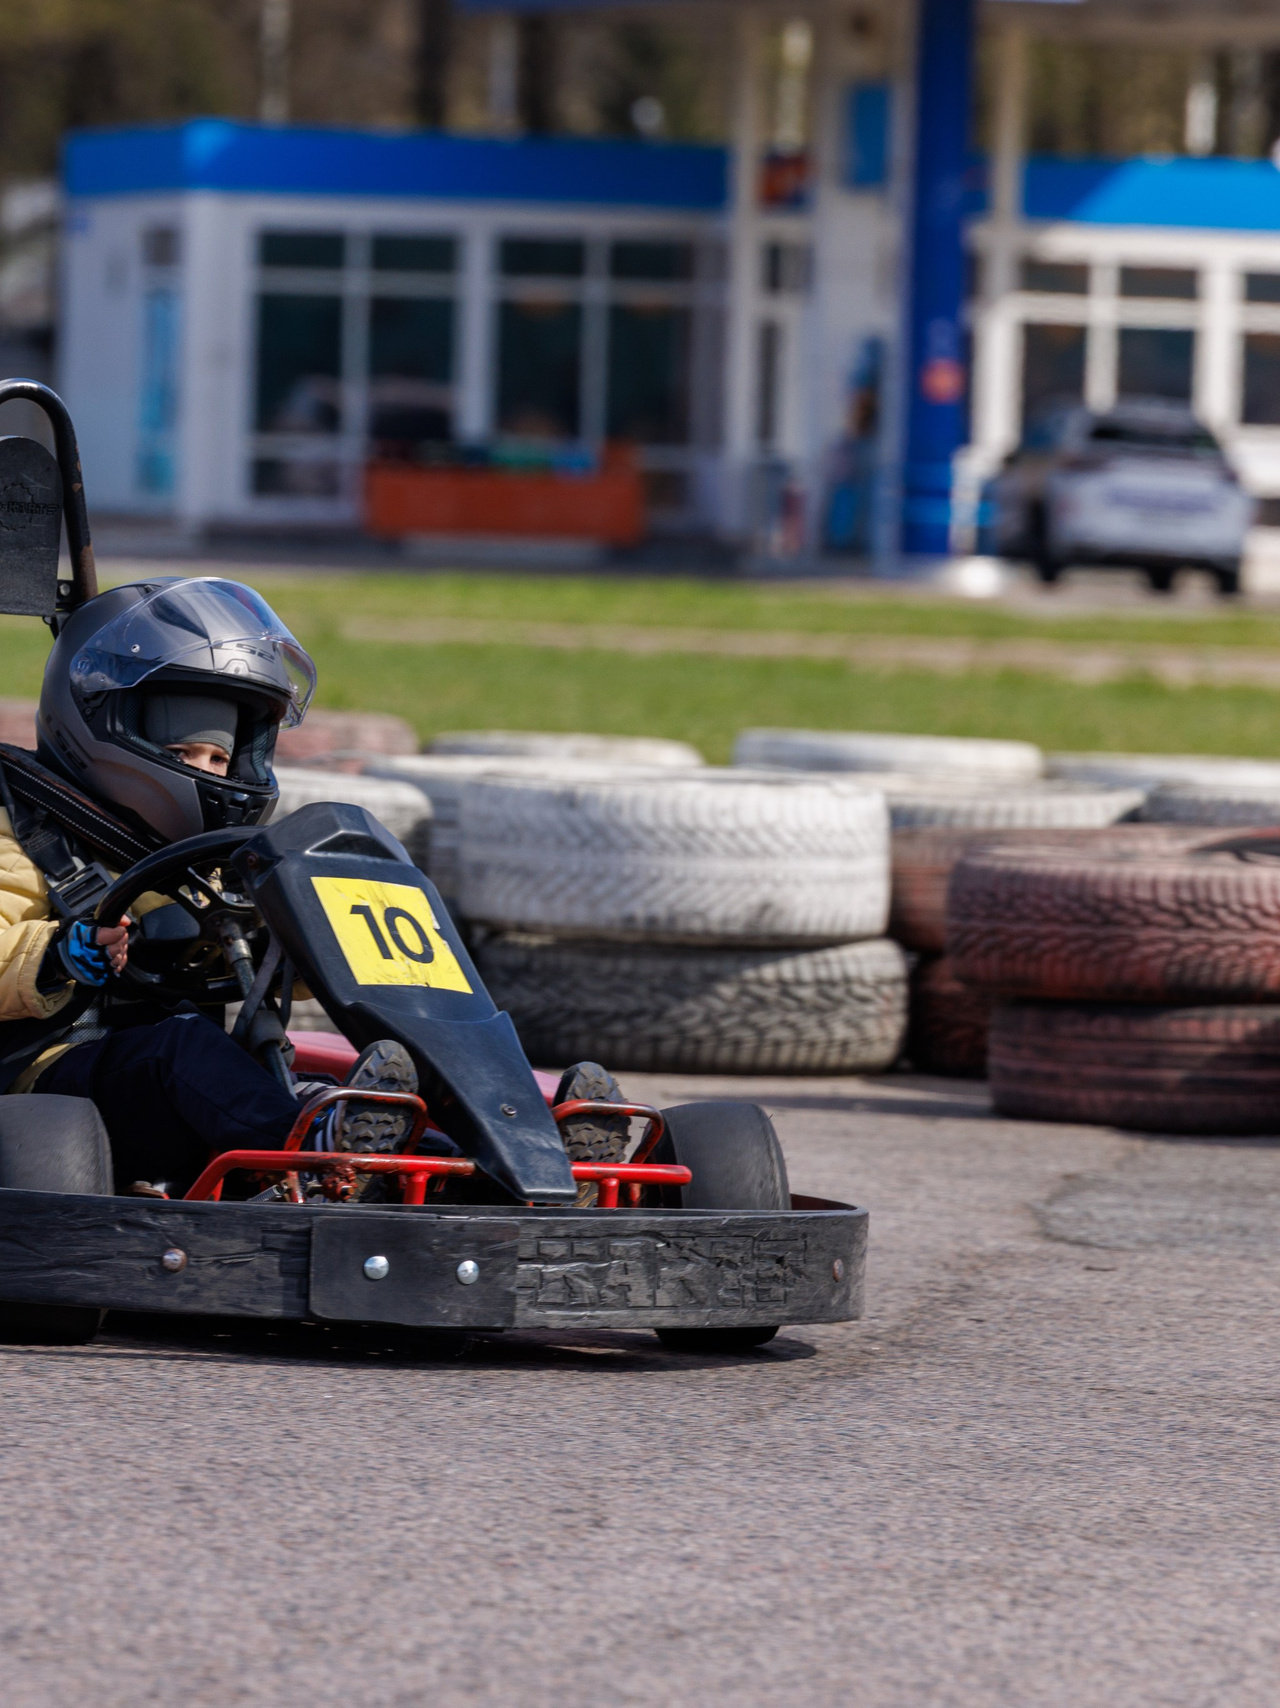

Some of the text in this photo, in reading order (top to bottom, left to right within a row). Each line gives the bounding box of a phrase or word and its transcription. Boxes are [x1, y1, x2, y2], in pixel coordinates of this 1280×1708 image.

[213, 640, 275, 664] LS2
[45, 714, 88, 772] LS2
[350, 904, 434, 964] 10
